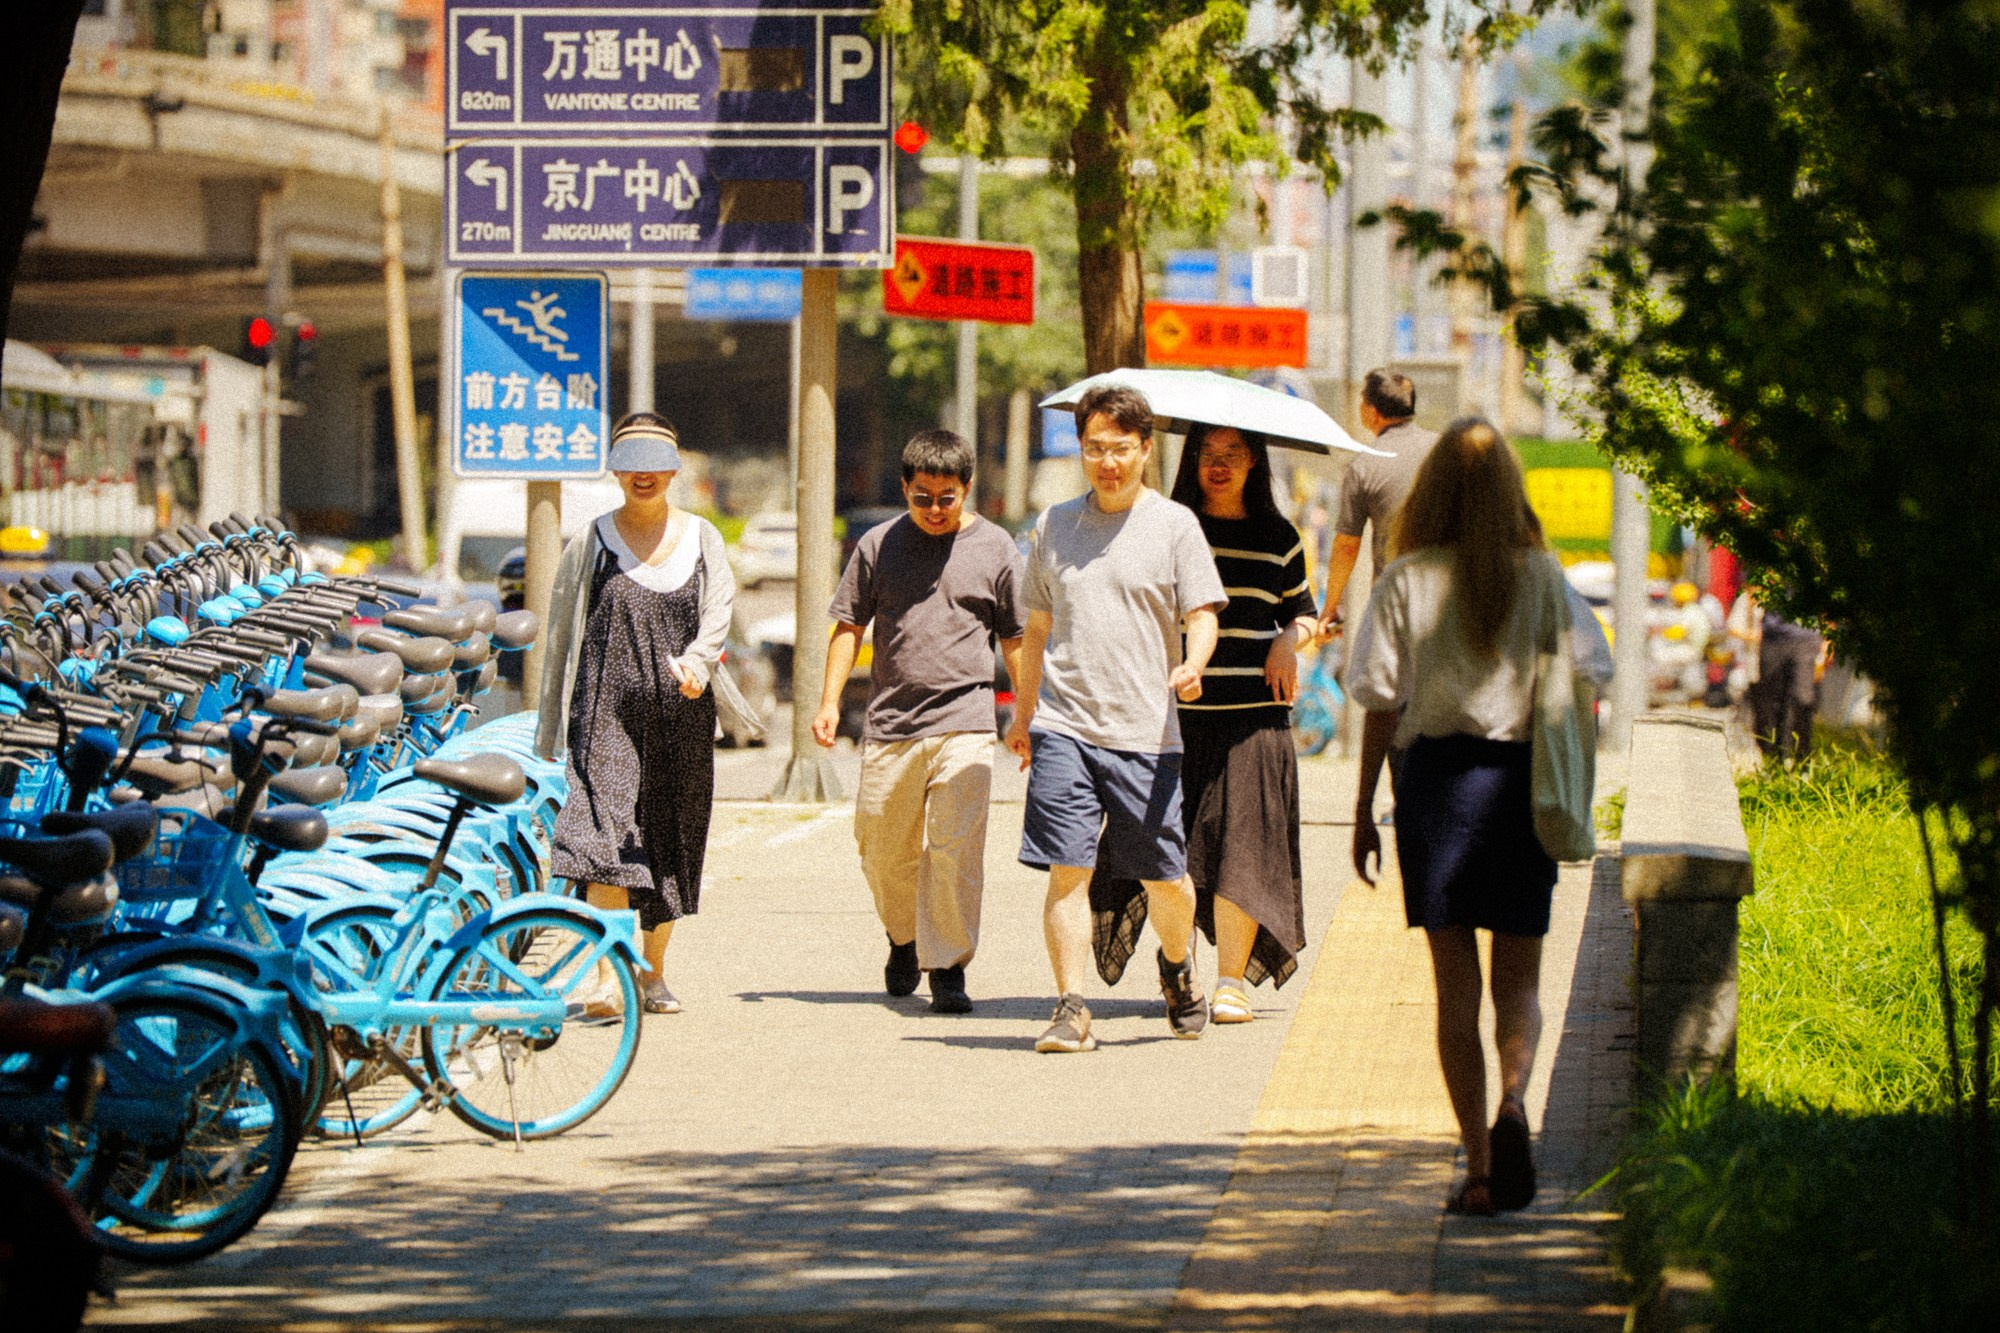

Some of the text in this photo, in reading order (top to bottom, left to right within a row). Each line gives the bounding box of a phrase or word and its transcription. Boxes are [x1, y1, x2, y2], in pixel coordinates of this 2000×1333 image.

[542, 28, 701, 82] 万通中心
[829, 35, 874, 104] P
[461, 91, 511, 110] 820m
[543, 93, 700, 111] VANTONE CENTRE
[542, 159, 701, 212] 京广中心
[829, 165, 874, 234] P
[461, 222, 511, 241] 270m
[542, 222, 701, 241] JINGGUANG CENTRE
[464, 371, 598, 410] 前方台阶
[464, 422, 598, 461] 注意安全
